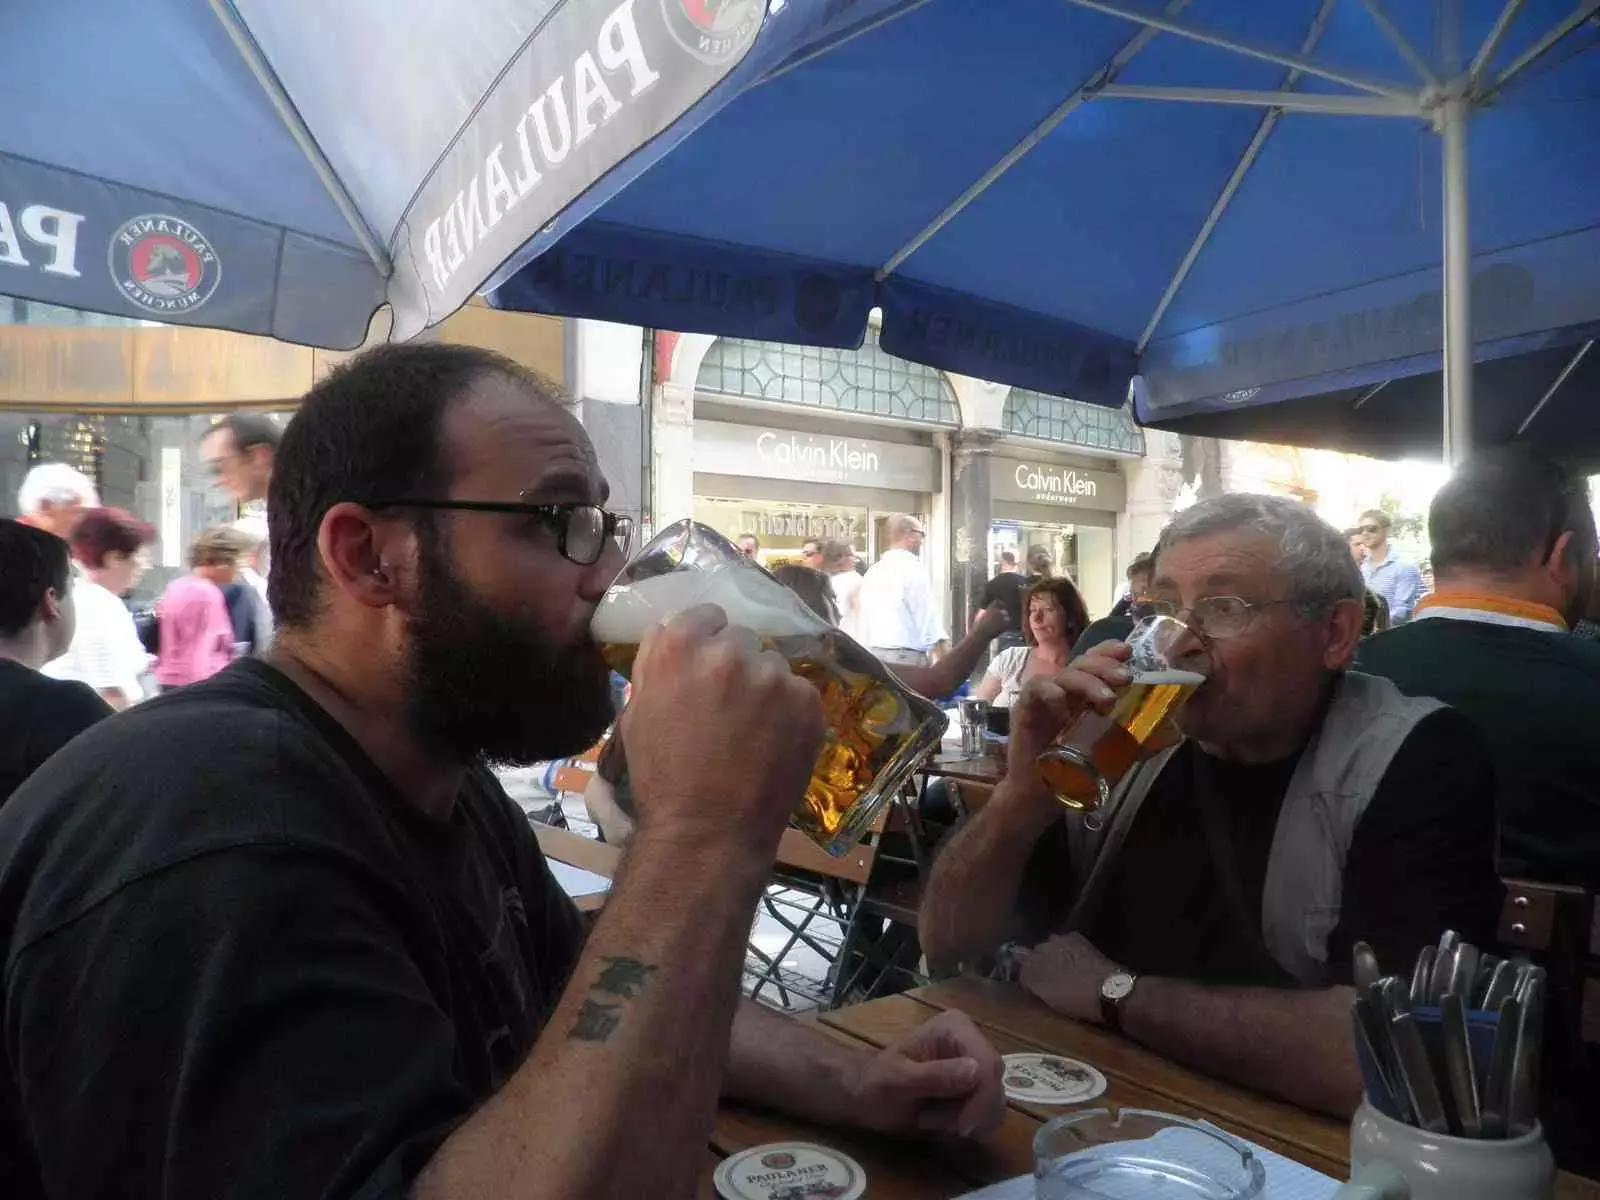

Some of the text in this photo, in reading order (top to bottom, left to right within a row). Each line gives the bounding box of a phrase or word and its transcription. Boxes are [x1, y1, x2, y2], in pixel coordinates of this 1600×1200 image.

[756, 431, 879, 472] Calvin Klein
[1015, 464, 1097, 497] Calvin Klein
[745, 1163, 829, 1184] PAULANER
